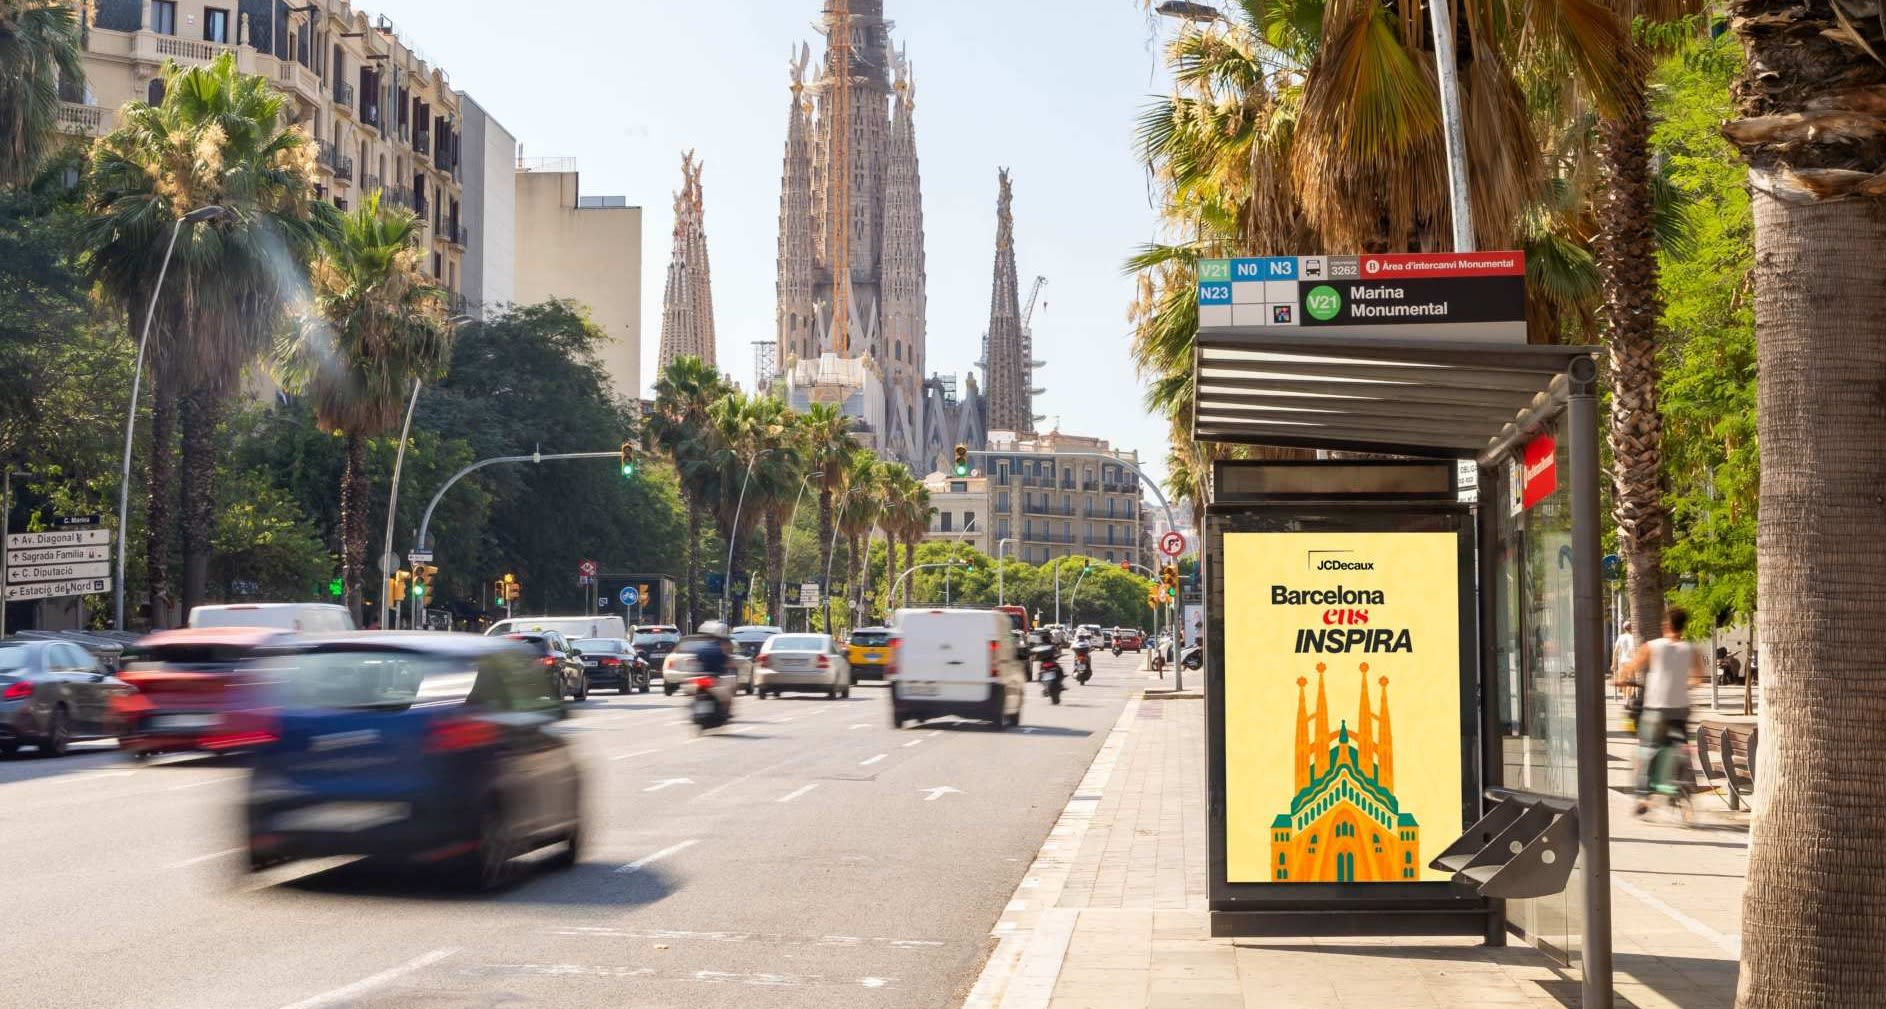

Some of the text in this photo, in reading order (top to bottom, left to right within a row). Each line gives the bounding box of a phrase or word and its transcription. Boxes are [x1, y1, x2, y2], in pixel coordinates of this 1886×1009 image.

[1201, 264, 1228, 278] V21
[1270, 261, 1292, 275] N3
[1331, 266, 1357, 275] 3262
[1405, 260, 1457, 270] d'intercanvi
[1458, 259, 1514, 269] Monumental
[1200, 287, 1229, 300] N23
[1350, 285, 1404, 300] Marina
[1308, 295, 1337, 309] V21
[1351, 301, 1448, 318] Monumental
[22, 533, 74, 544] Av. Diagonal
[22, 551, 54, 562] Sagrada
[22, 566, 73, 578] C. Diputació
[1317, 560, 1374, 570] JCDecaux
[20, 586, 51, 596] Estació
[70, 582, 91, 592] Nord
[1271, 585, 1384, 605] Barcelona
[1323, 608, 1369, 625] ens
[1295, 629, 1413, 653] INSPIRA
